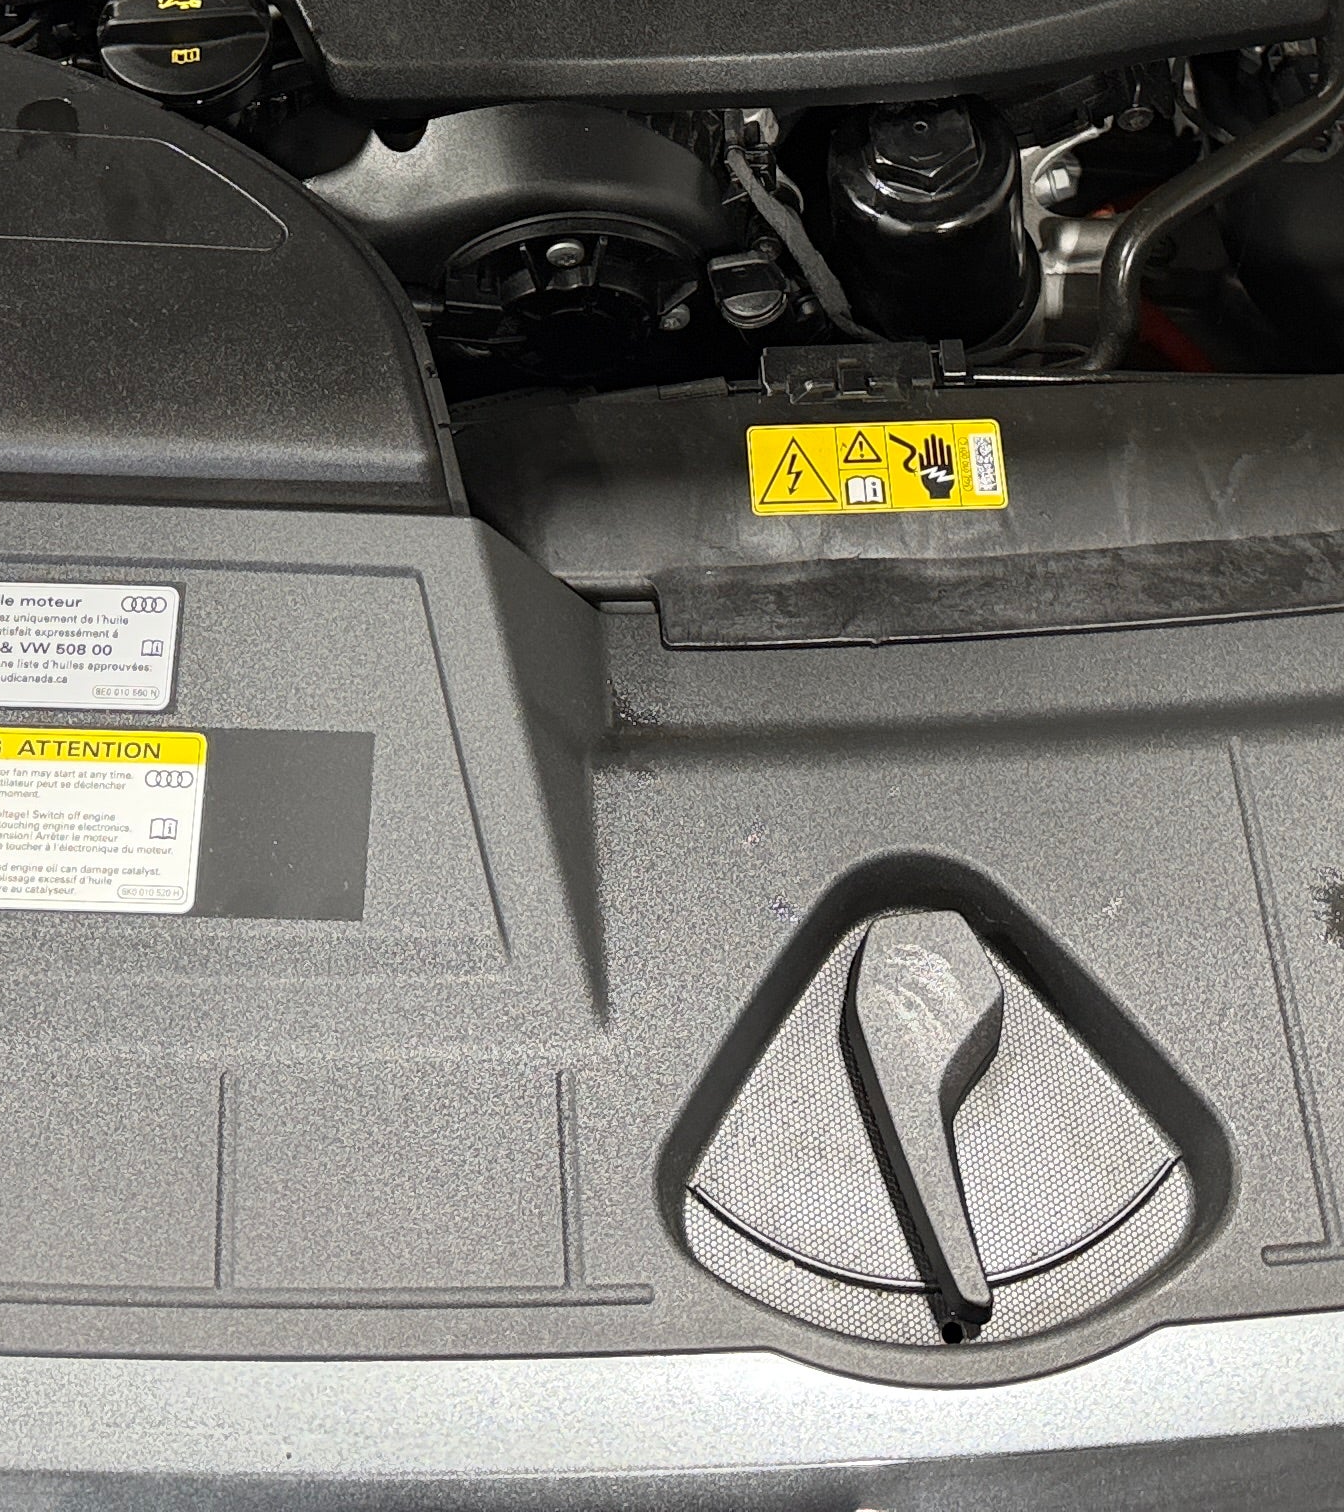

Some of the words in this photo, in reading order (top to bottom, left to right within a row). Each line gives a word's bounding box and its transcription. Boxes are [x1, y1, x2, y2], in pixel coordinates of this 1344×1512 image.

[20, 596, 82, 608] moteur
[13, 614, 77, 624] uniquement
[81, 615, 93, 624] de
[0, 642, 13, 654] &
[20, 642, 51, 654] VW
[56, 643, 86, 655] 508
[91, 644, 112, 656] 00
[17, 659, 39, 669] liste
[18, 739, 162, 759] ATTENTION
[13, 768, 28, 777] fan
[55, 769, 75, 778] start
[78, 770, 87, 779] at
[90, 772, 107, 780] any
[32, 810, 64, 820] Switch
[68, 811, 81, 820] off
[83, 812, 115, 823] engine
[43, 823, 75, 833] engine
[83, 834, 118, 843] moteur
[11, 863, 44, 874] engine
[61, 864, 77, 873] can
[80, 865, 119, 876] damage
